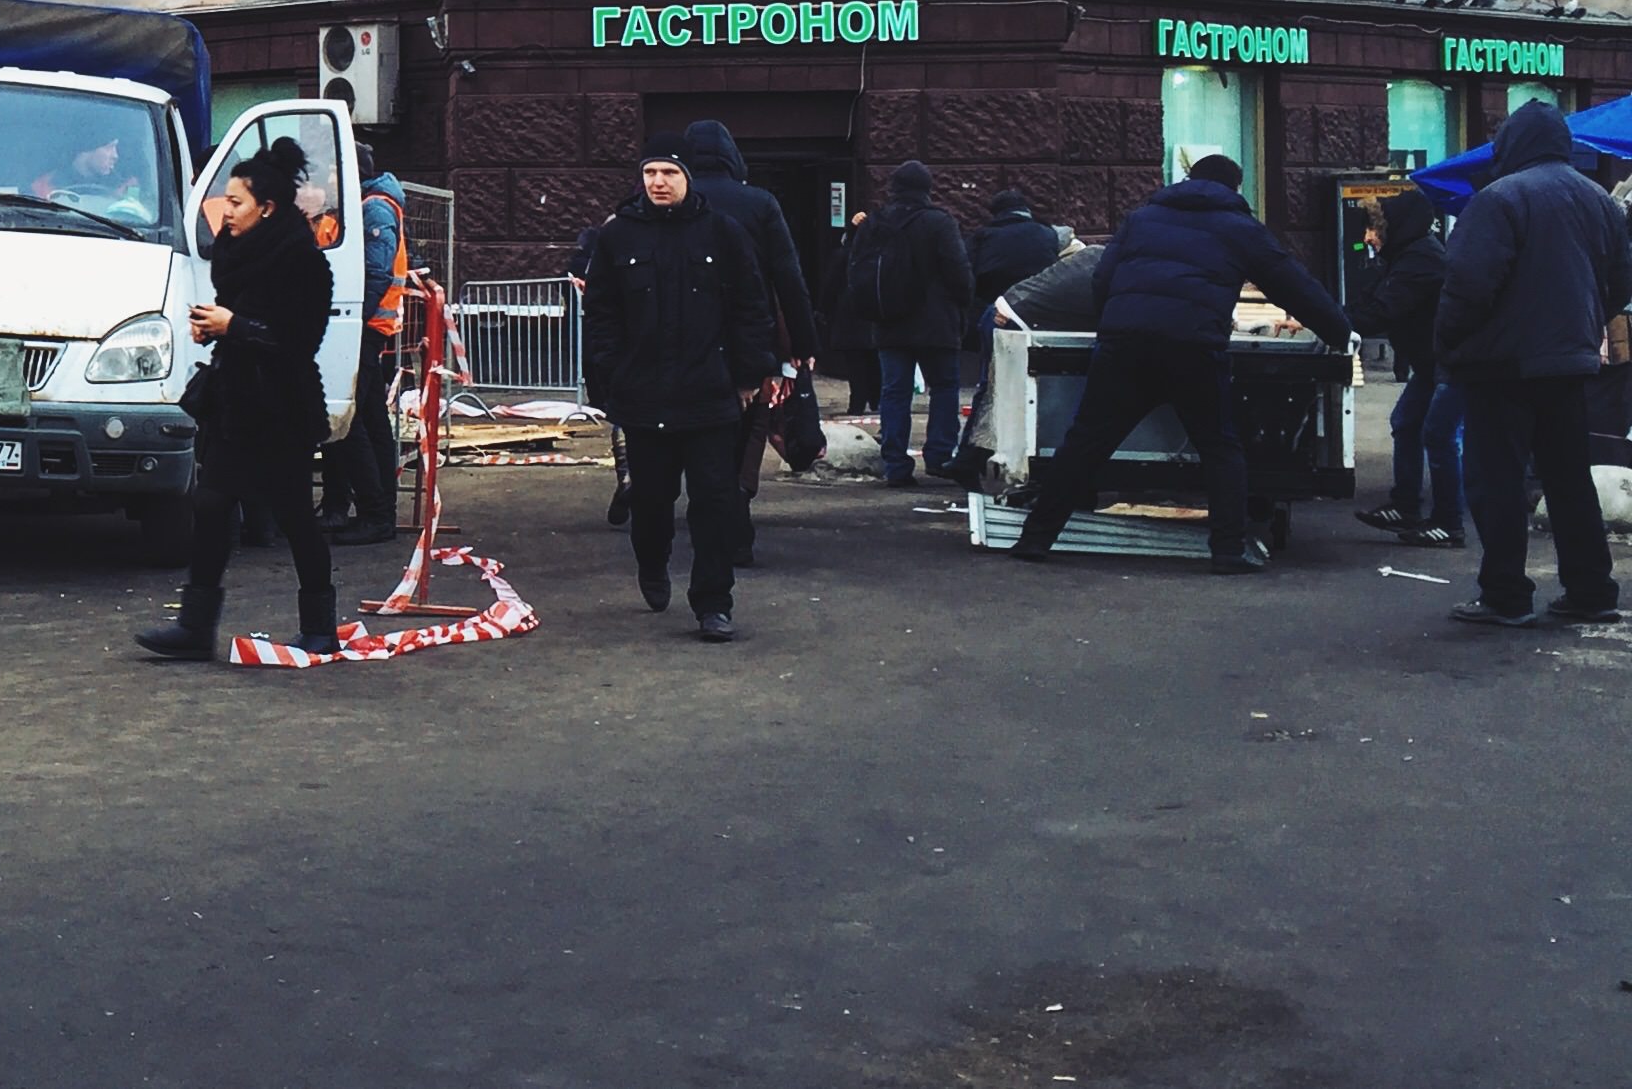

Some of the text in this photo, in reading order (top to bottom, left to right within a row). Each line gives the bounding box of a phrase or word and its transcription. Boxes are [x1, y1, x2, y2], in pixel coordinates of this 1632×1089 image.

[593, 0, 919, 48] ГАСТРОНОМ
[1157, 18, 1309, 64] ГАСТРОНОМ
[1443, 37, 1565, 77] ГАСТРОНОМ
